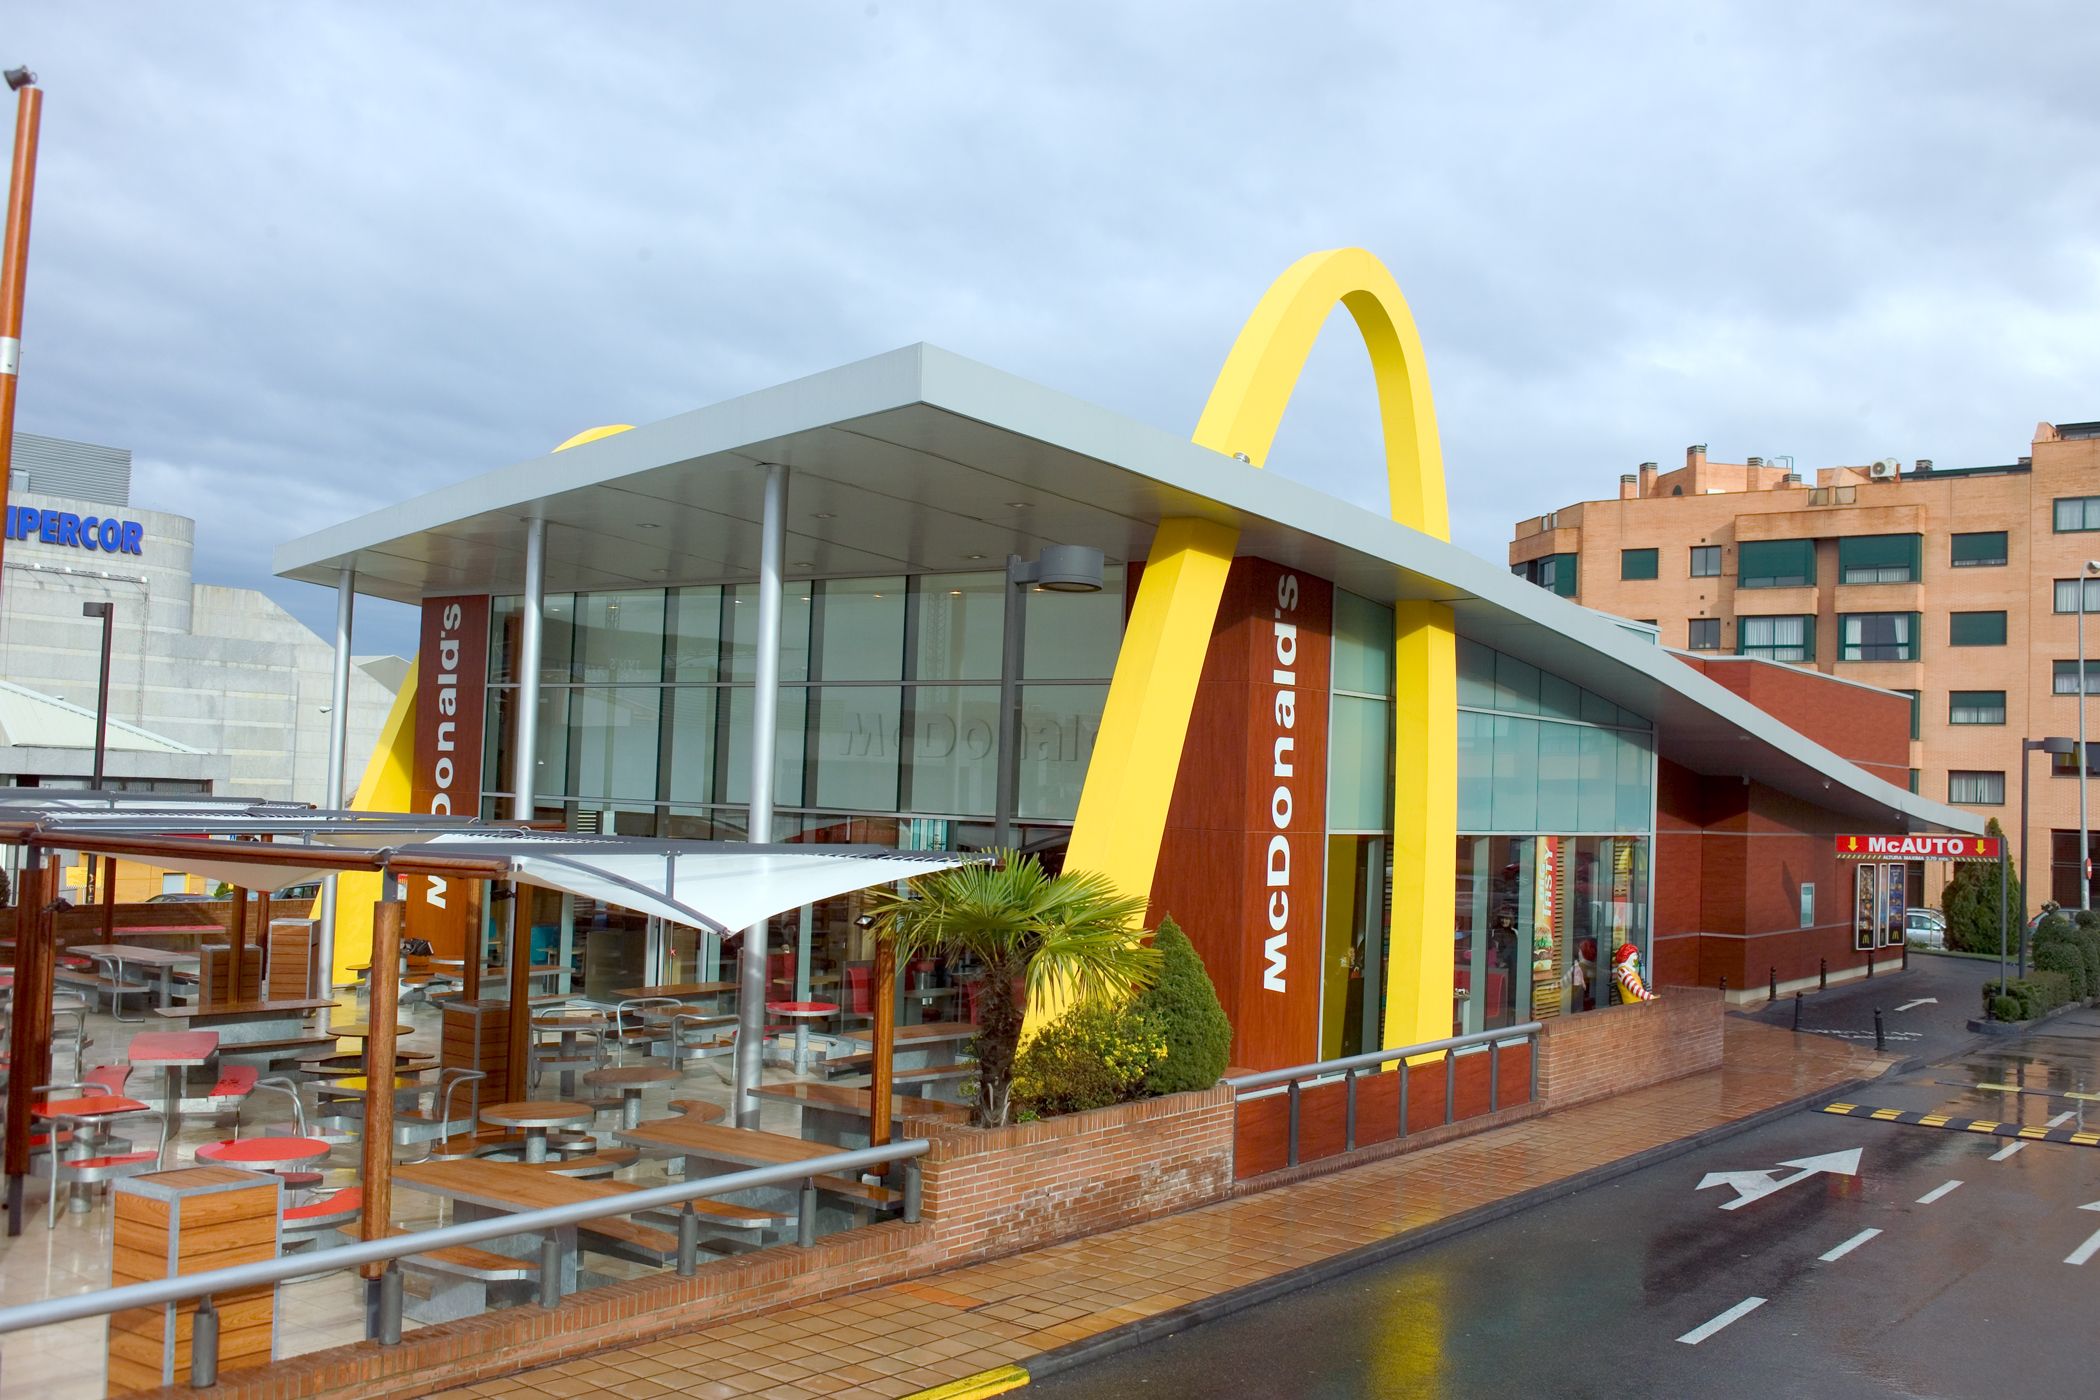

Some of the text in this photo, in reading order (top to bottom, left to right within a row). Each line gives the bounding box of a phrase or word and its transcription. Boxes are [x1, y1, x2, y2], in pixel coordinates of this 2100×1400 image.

[6, 505, 143, 556] IPERCOR
[426, 603, 462, 910] MDonald's
[1263, 574, 1299, 994] McDonald's
[1542, 845, 1554, 917] TASTY
[1868, 837, 1964, 854] McAUTO
